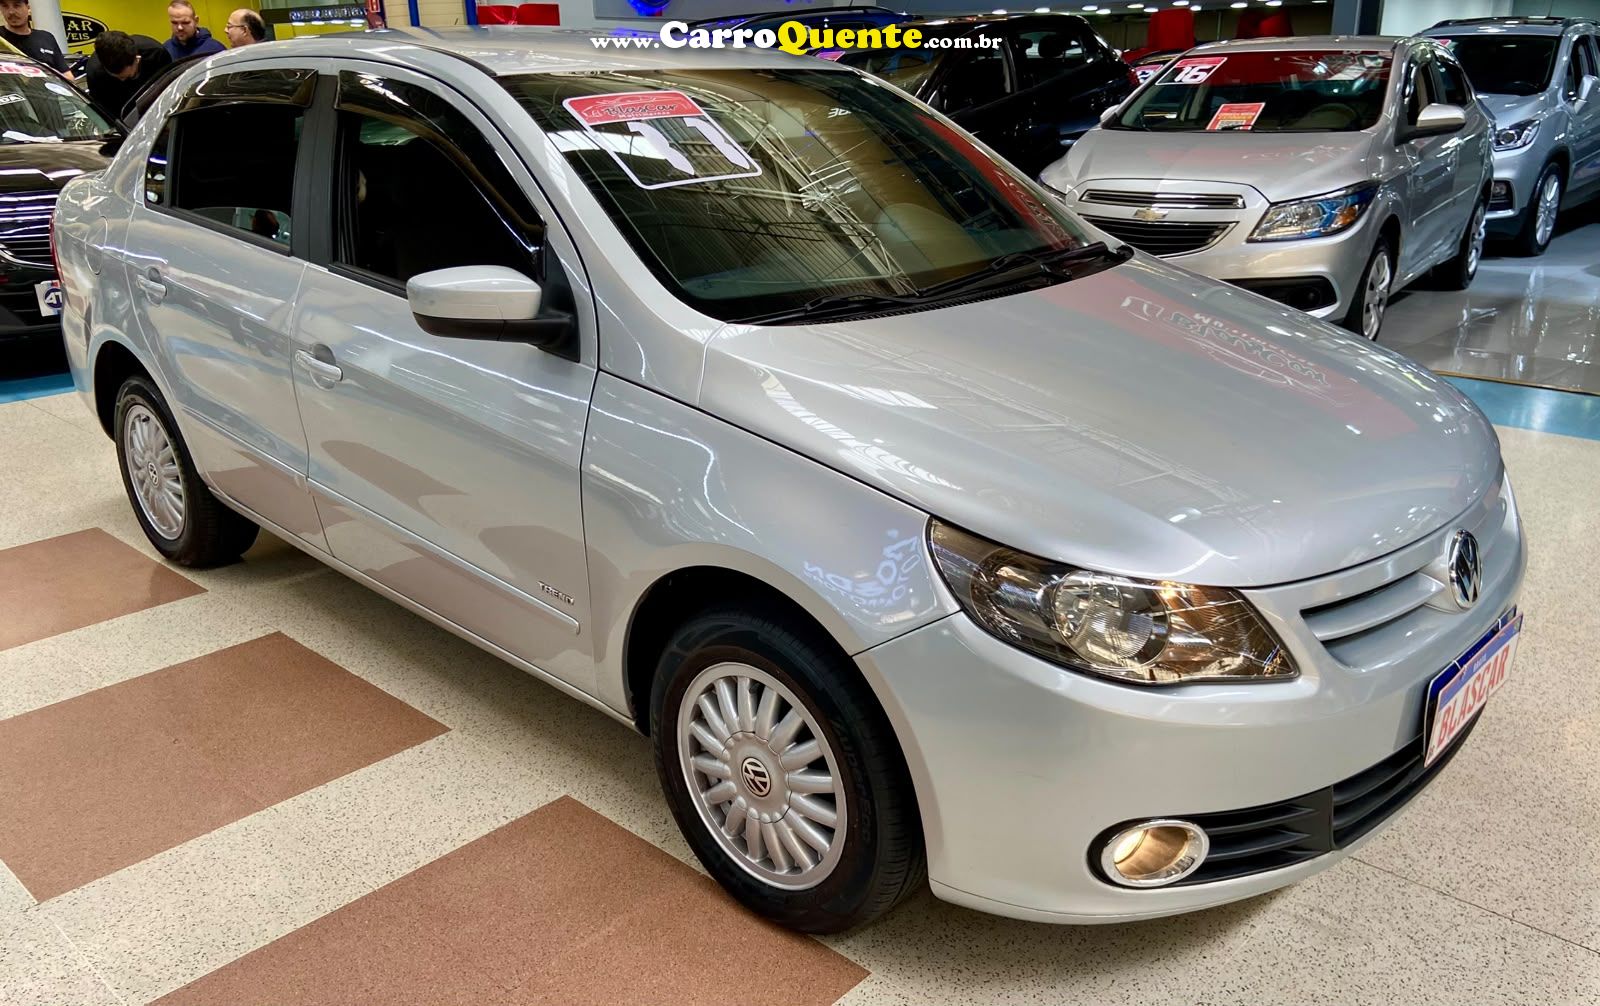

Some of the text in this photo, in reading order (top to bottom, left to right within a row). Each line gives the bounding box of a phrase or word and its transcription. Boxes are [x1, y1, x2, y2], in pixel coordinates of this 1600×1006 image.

[1174, 65, 1213, 83] 16
[604, 103, 677, 117] BlasCar
[537, 580, 574, 606] TREND
[1437, 644, 1510, 748] BLASCAR
